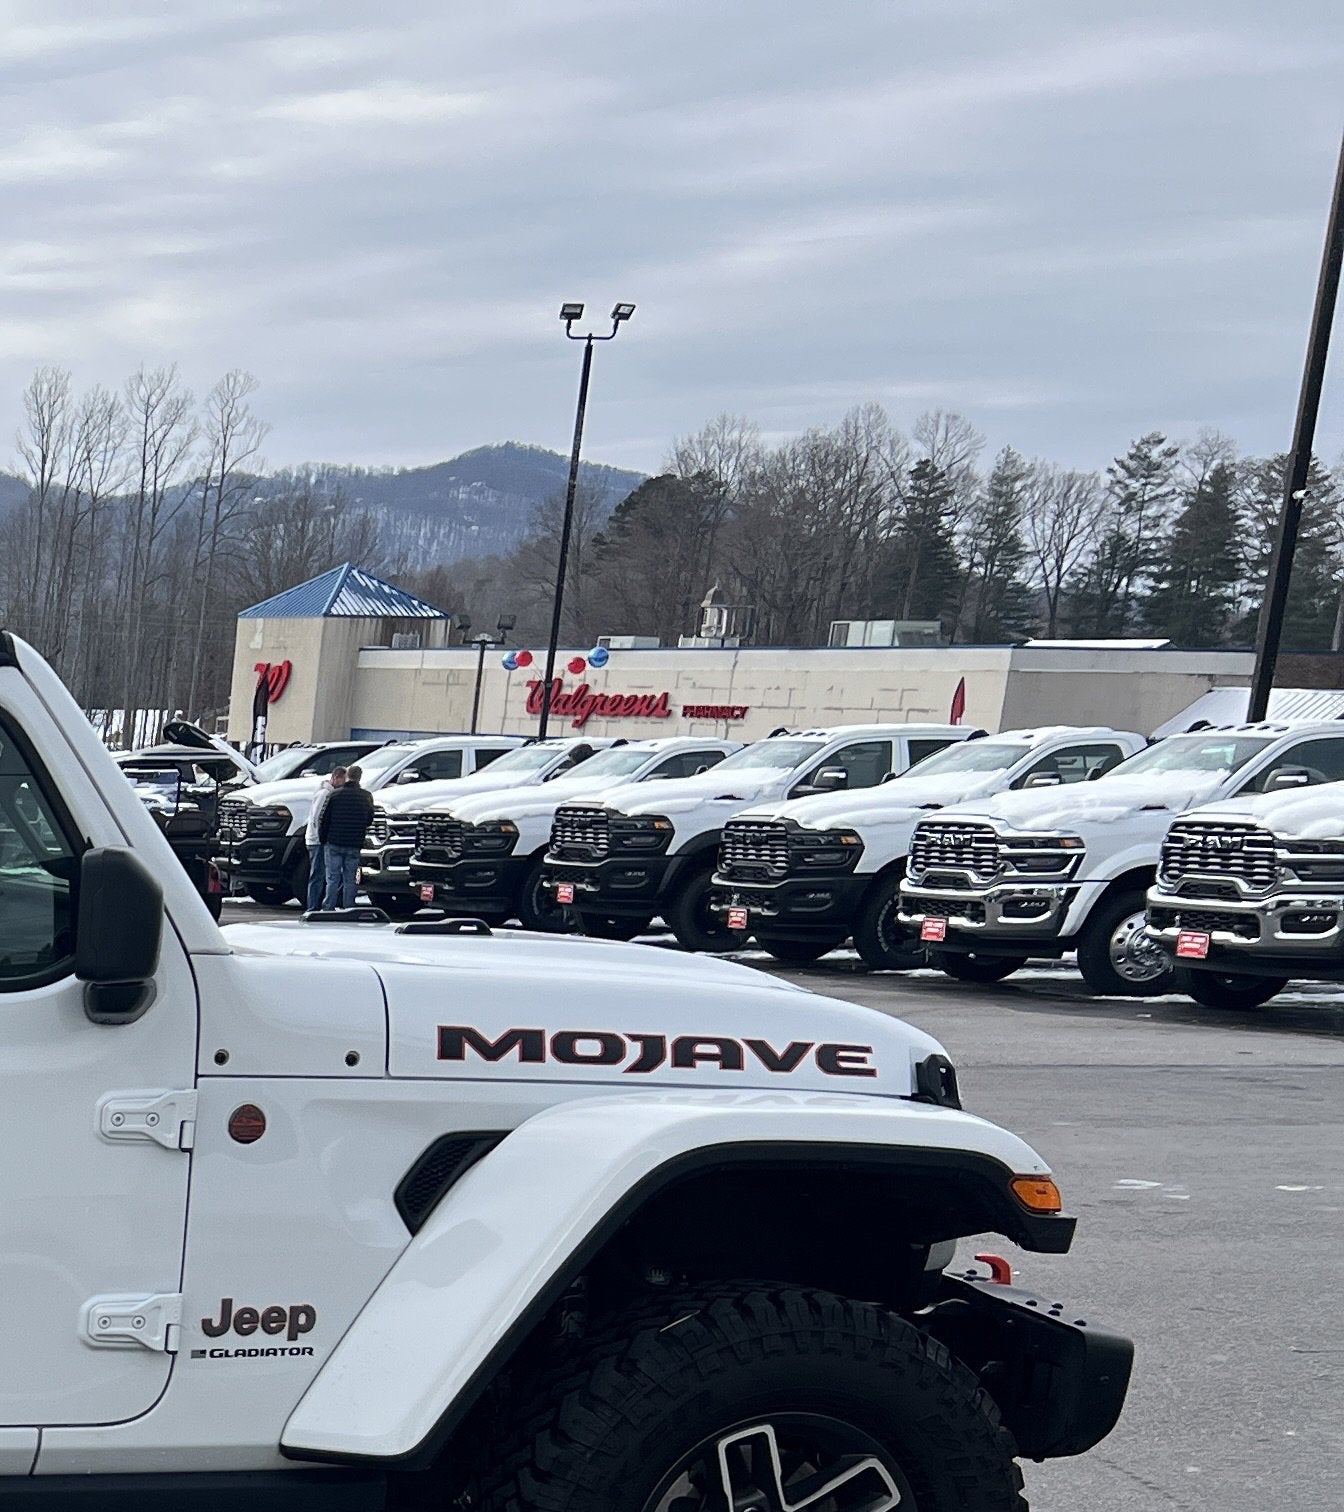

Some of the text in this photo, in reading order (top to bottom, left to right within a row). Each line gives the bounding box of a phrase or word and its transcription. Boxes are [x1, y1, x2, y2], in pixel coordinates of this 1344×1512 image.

[525, 677, 672, 728] Walgreens
[681, 704, 749, 720] PHARMACY
[924, 833, 976, 847] RAM
[436, 1024, 877, 1078] MOJAVE
[201, 1298, 317, 1341] Jeep
[209, 1347, 314, 1358] GLADIATOR
